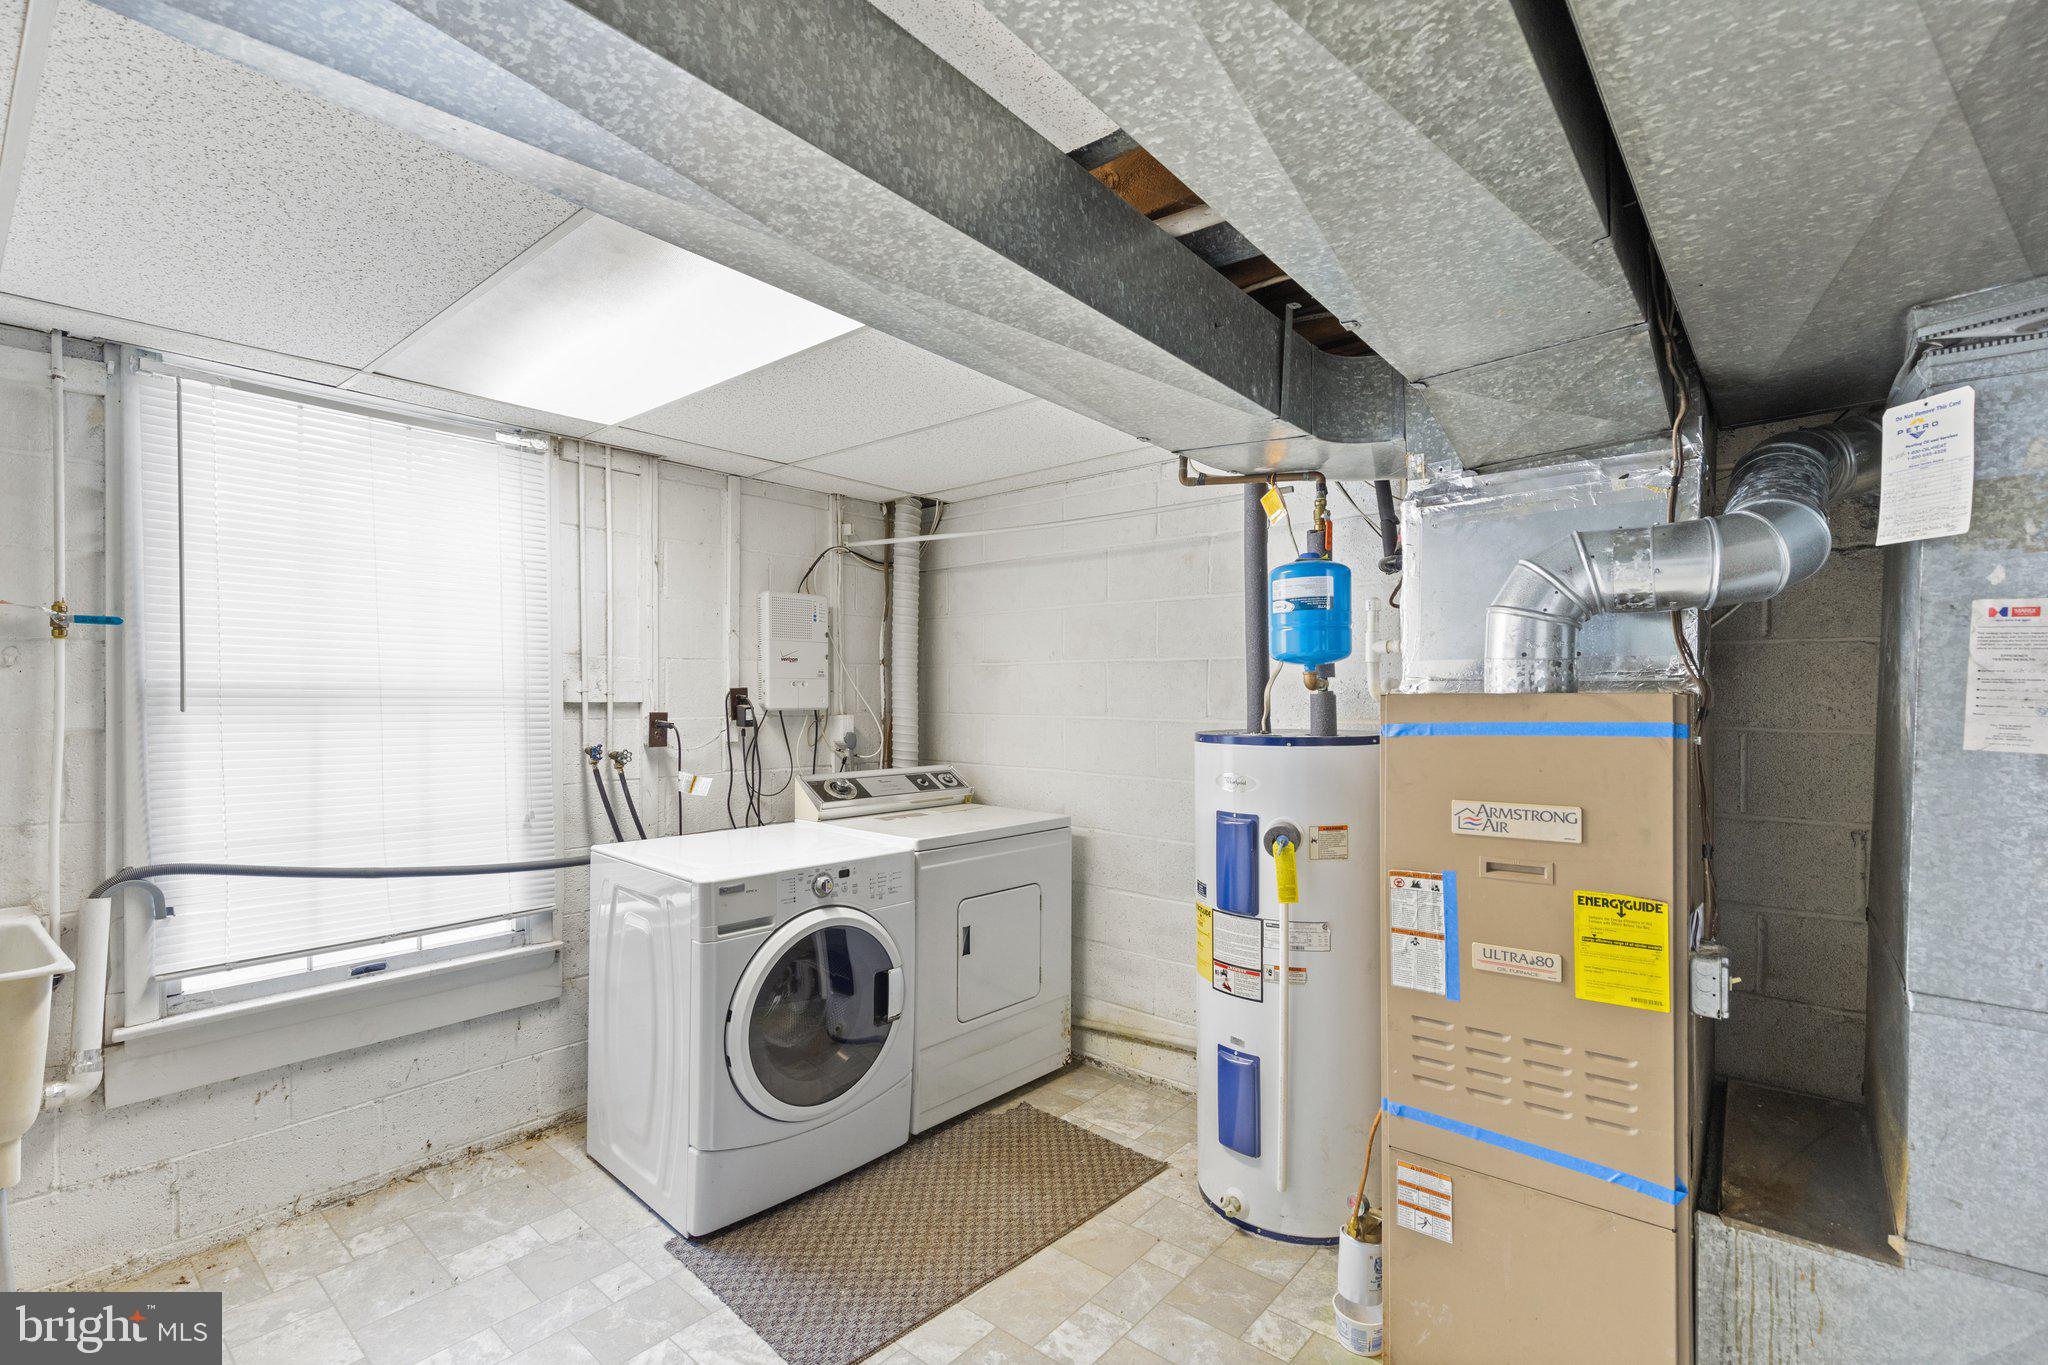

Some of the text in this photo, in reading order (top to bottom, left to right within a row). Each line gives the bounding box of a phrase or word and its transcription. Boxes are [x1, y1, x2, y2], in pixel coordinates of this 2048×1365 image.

[1897, 421, 1939, 436] PETRO
[1476, 804, 1578, 824] ARMSTRONG
[1577, 895, 1664, 914] ENERGYGUIDE
[1482, 947, 1555, 969] ULTRA 80
